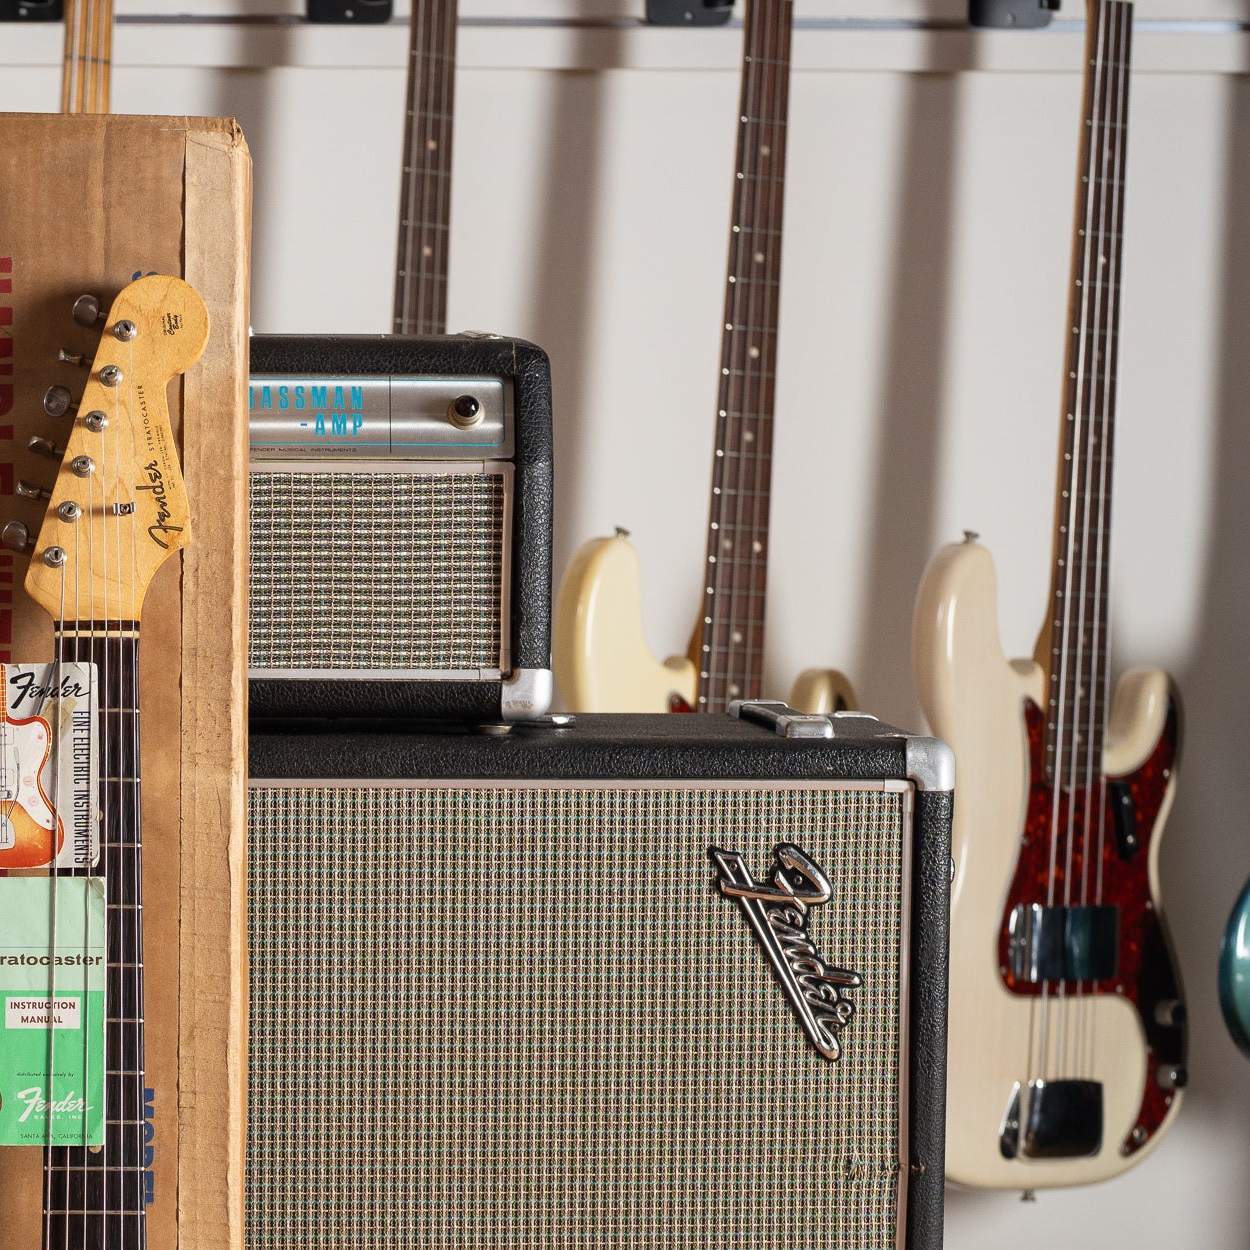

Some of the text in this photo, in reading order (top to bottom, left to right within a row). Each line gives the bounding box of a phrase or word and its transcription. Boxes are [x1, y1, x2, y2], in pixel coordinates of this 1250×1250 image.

[137, 384, 155, 452] STRATOCASTER
[136, 460, 183, 549] Fender
[10, 672, 90, 709] Fender
[72, 711, 91, 864] FINE ELECTRIC INSTRUMENTS
[708, 842, 864, 1061] Fender
[10, 1001, 76, 1010] INSTRUCTION
[17, 1086, 94, 1122] Fender
